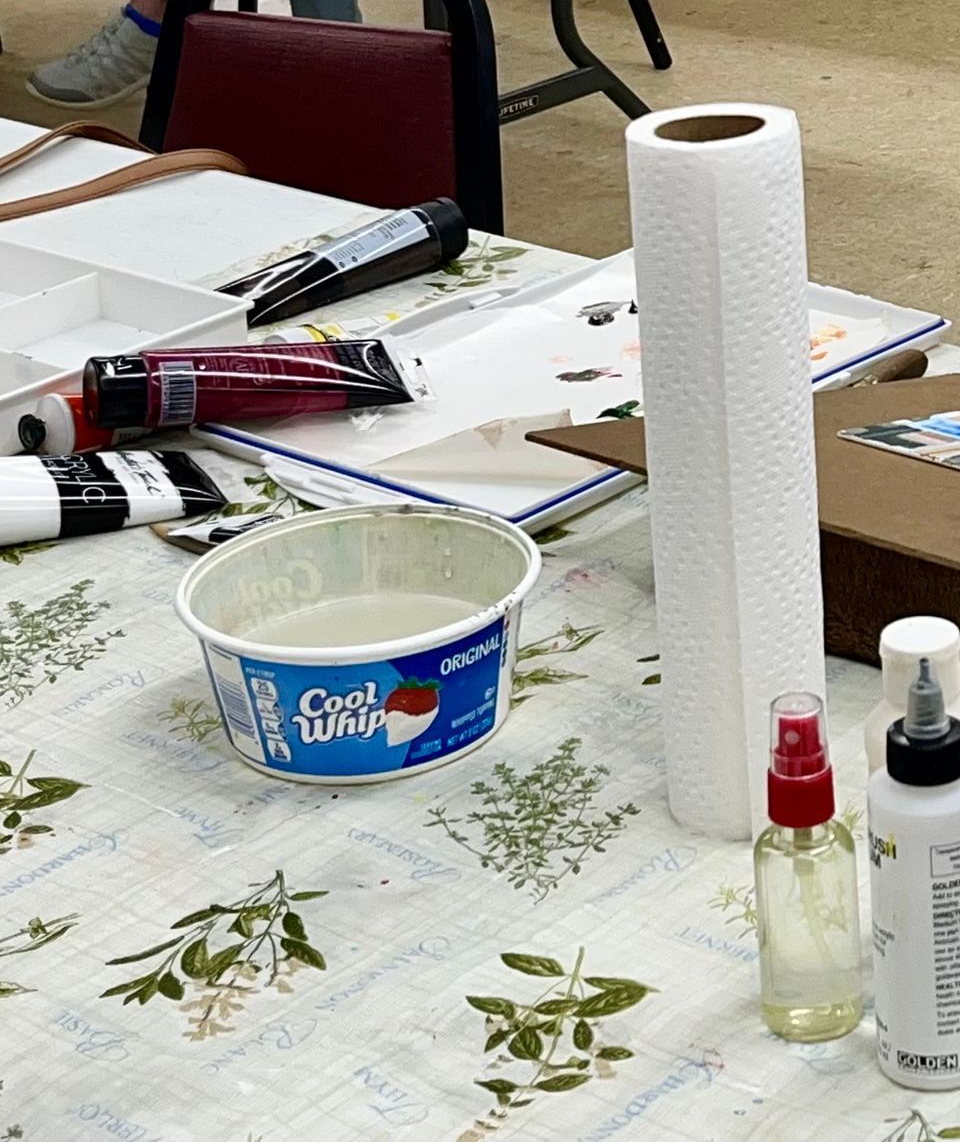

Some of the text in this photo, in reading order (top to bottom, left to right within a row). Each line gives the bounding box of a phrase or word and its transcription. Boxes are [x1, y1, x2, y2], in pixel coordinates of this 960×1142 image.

[499, 98, 535, 116] IFETIME
[440, 633, 500, 675] ORIGINAL
[300, 681, 378, 718] Cool
[291, 706, 386, 744] Whip
[898, 1050, 958, 1070] GOLDEN
